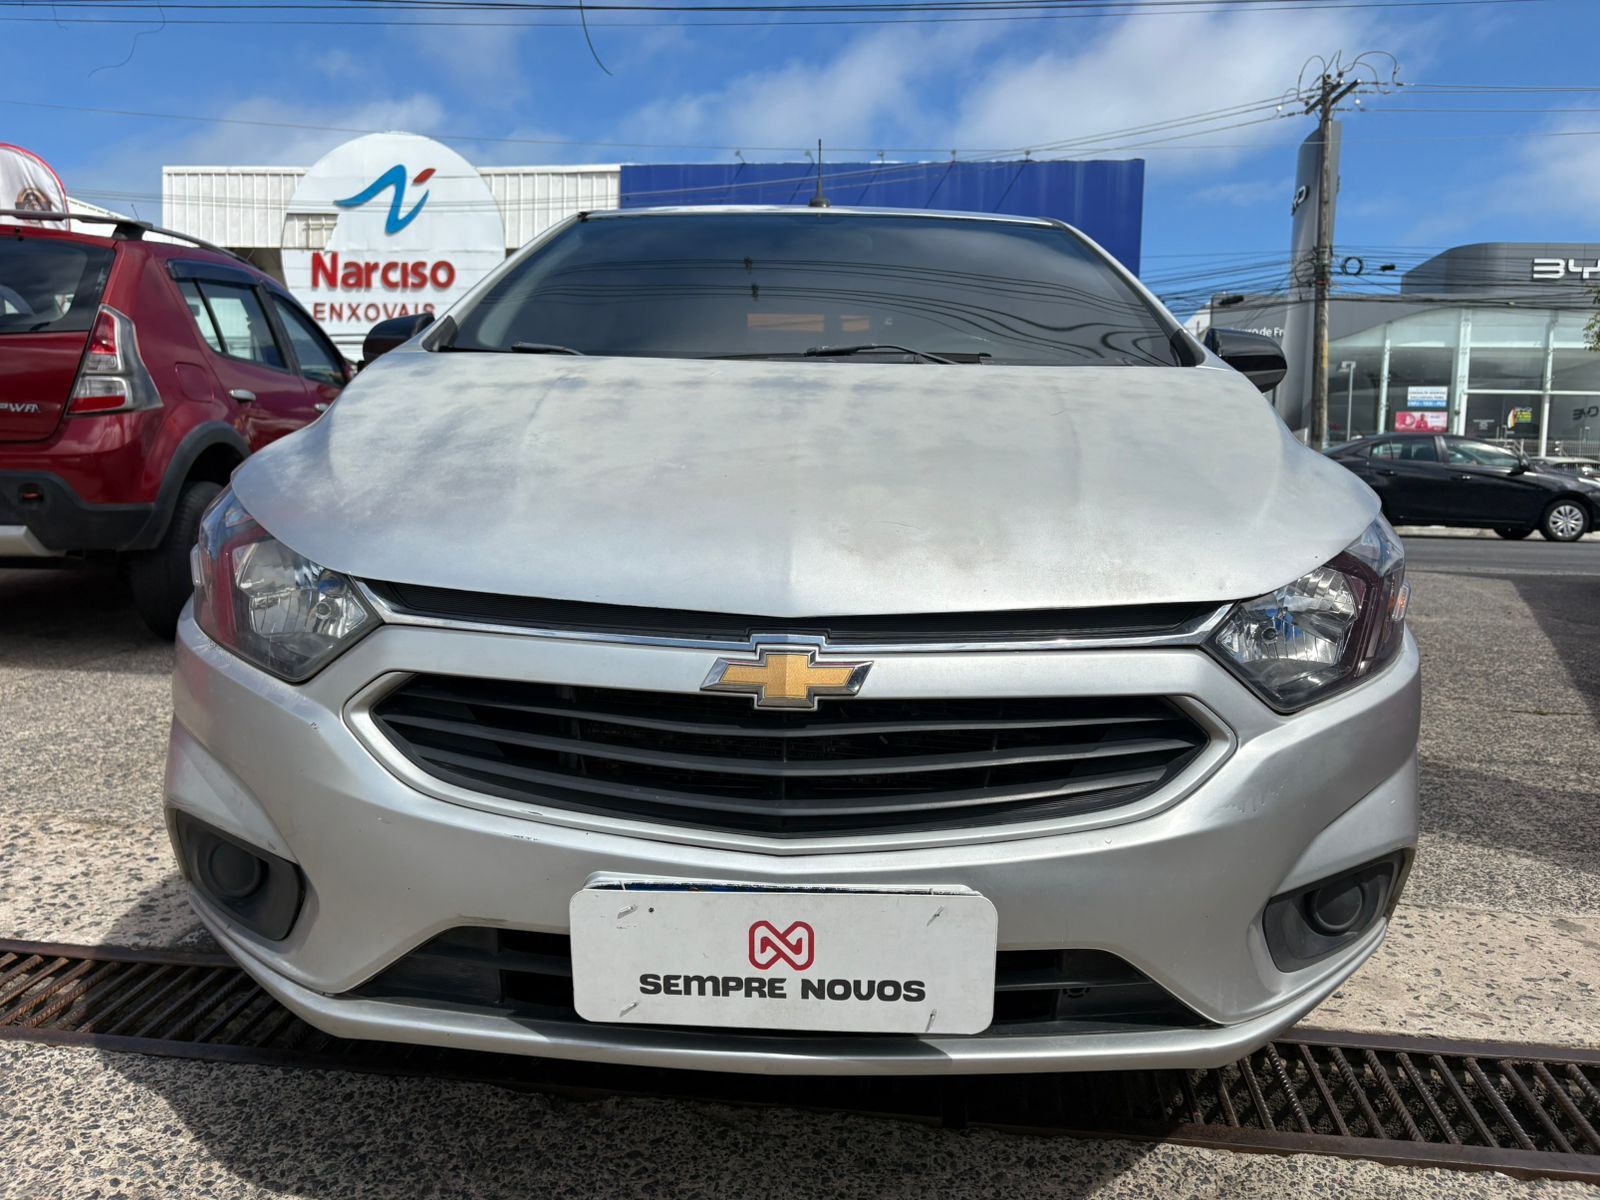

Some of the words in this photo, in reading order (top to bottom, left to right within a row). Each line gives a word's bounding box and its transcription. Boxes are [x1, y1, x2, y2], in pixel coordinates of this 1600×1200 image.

[311, 251, 456, 289] Narciso
[639, 973, 787, 999] SEMPRE
[801, 978, 926, 1002] NOVOS
